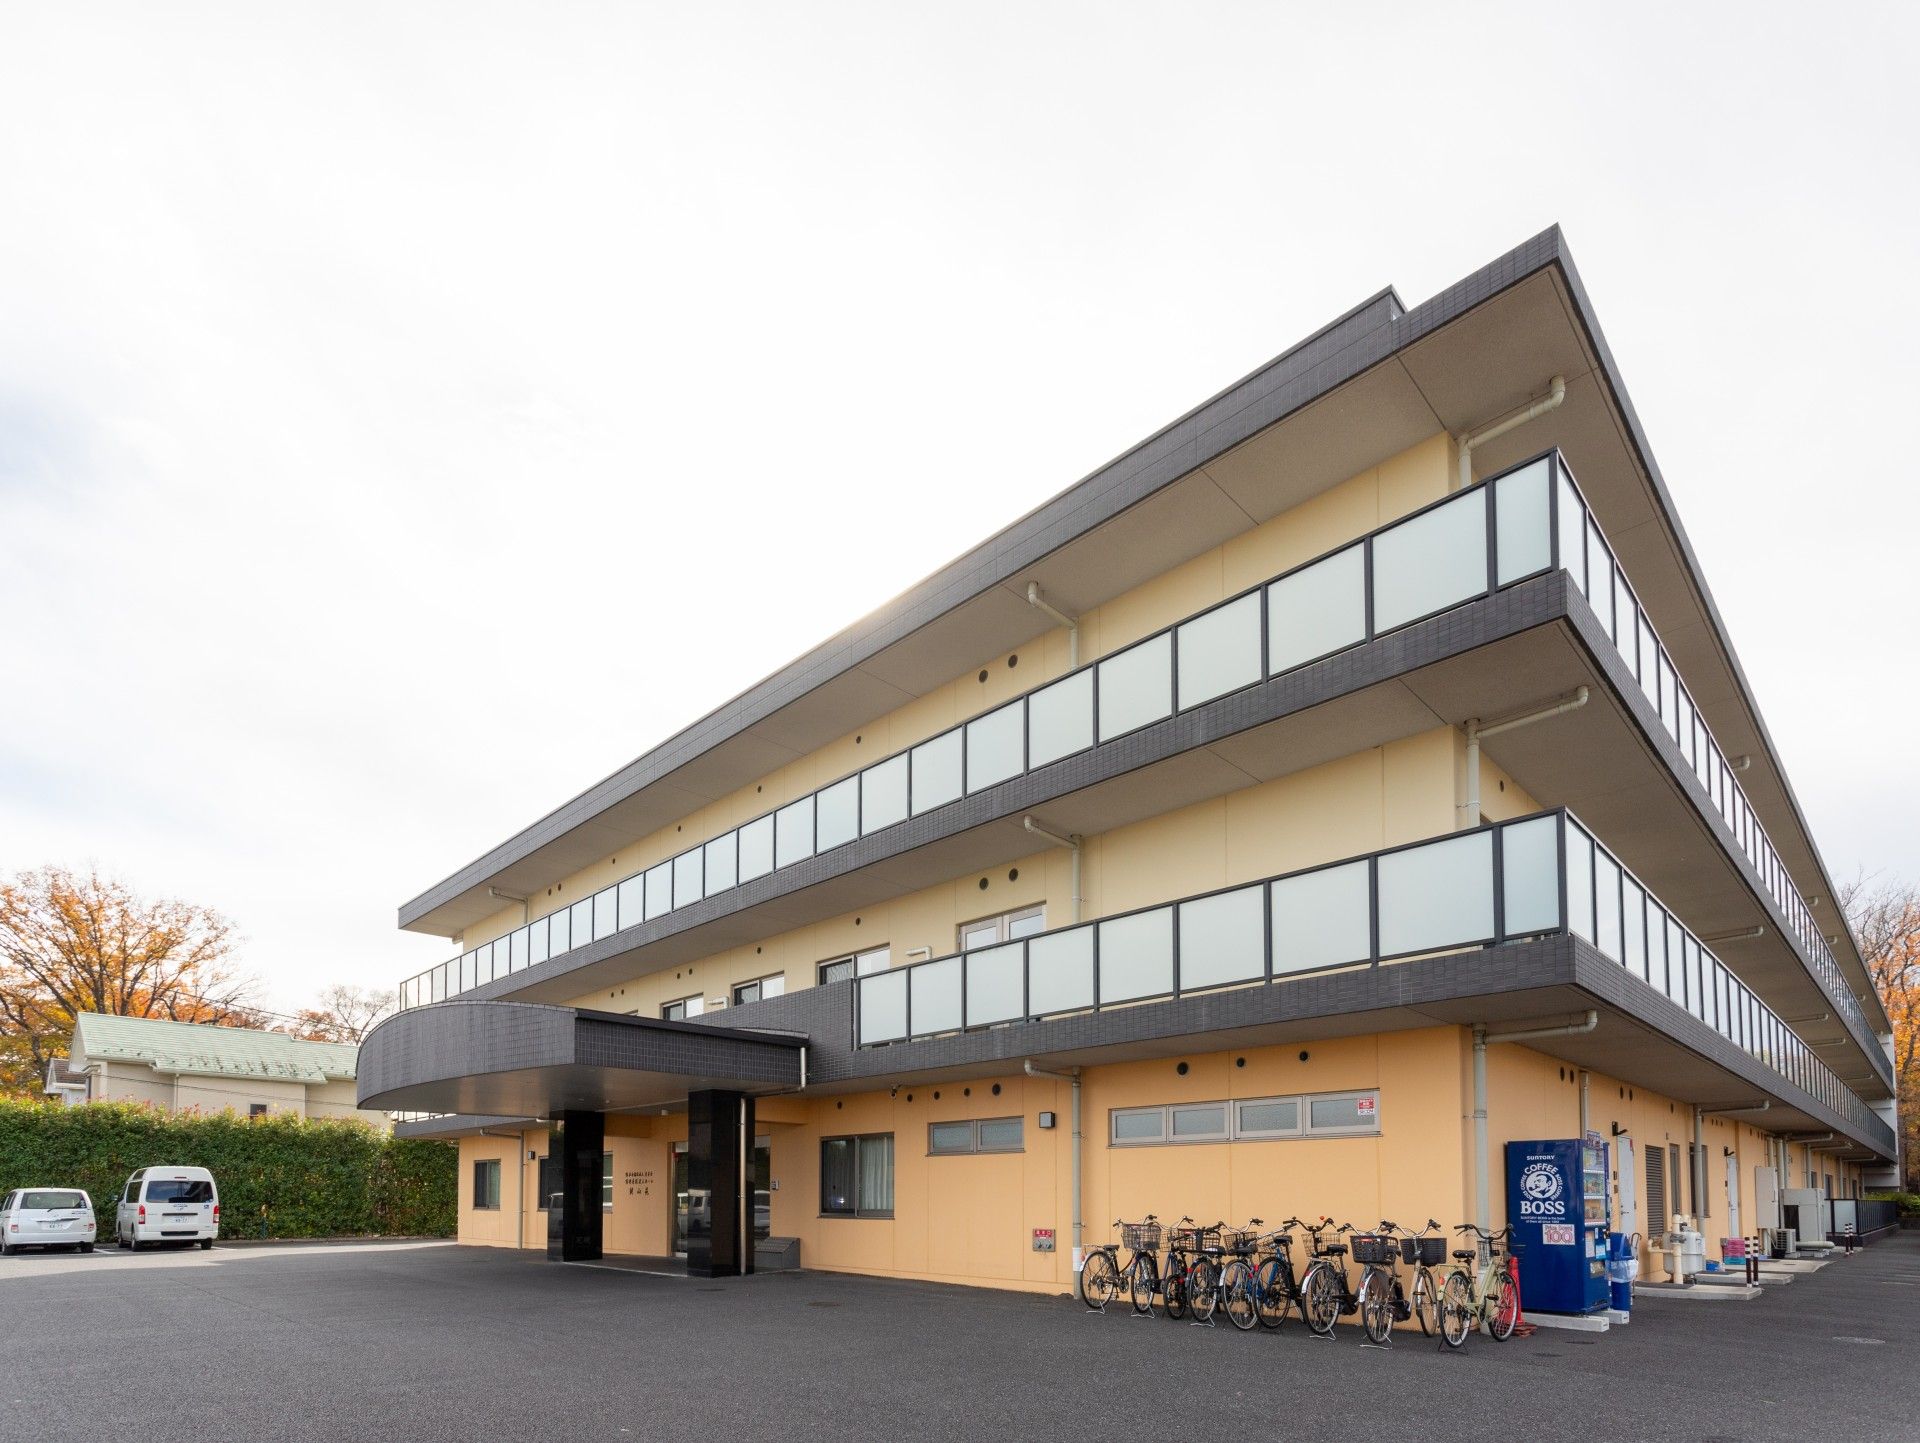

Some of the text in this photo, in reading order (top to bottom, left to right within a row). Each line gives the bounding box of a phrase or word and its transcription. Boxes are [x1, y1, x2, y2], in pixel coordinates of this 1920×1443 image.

[1524, 1163, 1559, 1174] COFFEE
[1520, 1200, 1565, 1215] BOSS
[1545, 1229, 1573, 1243] 100
